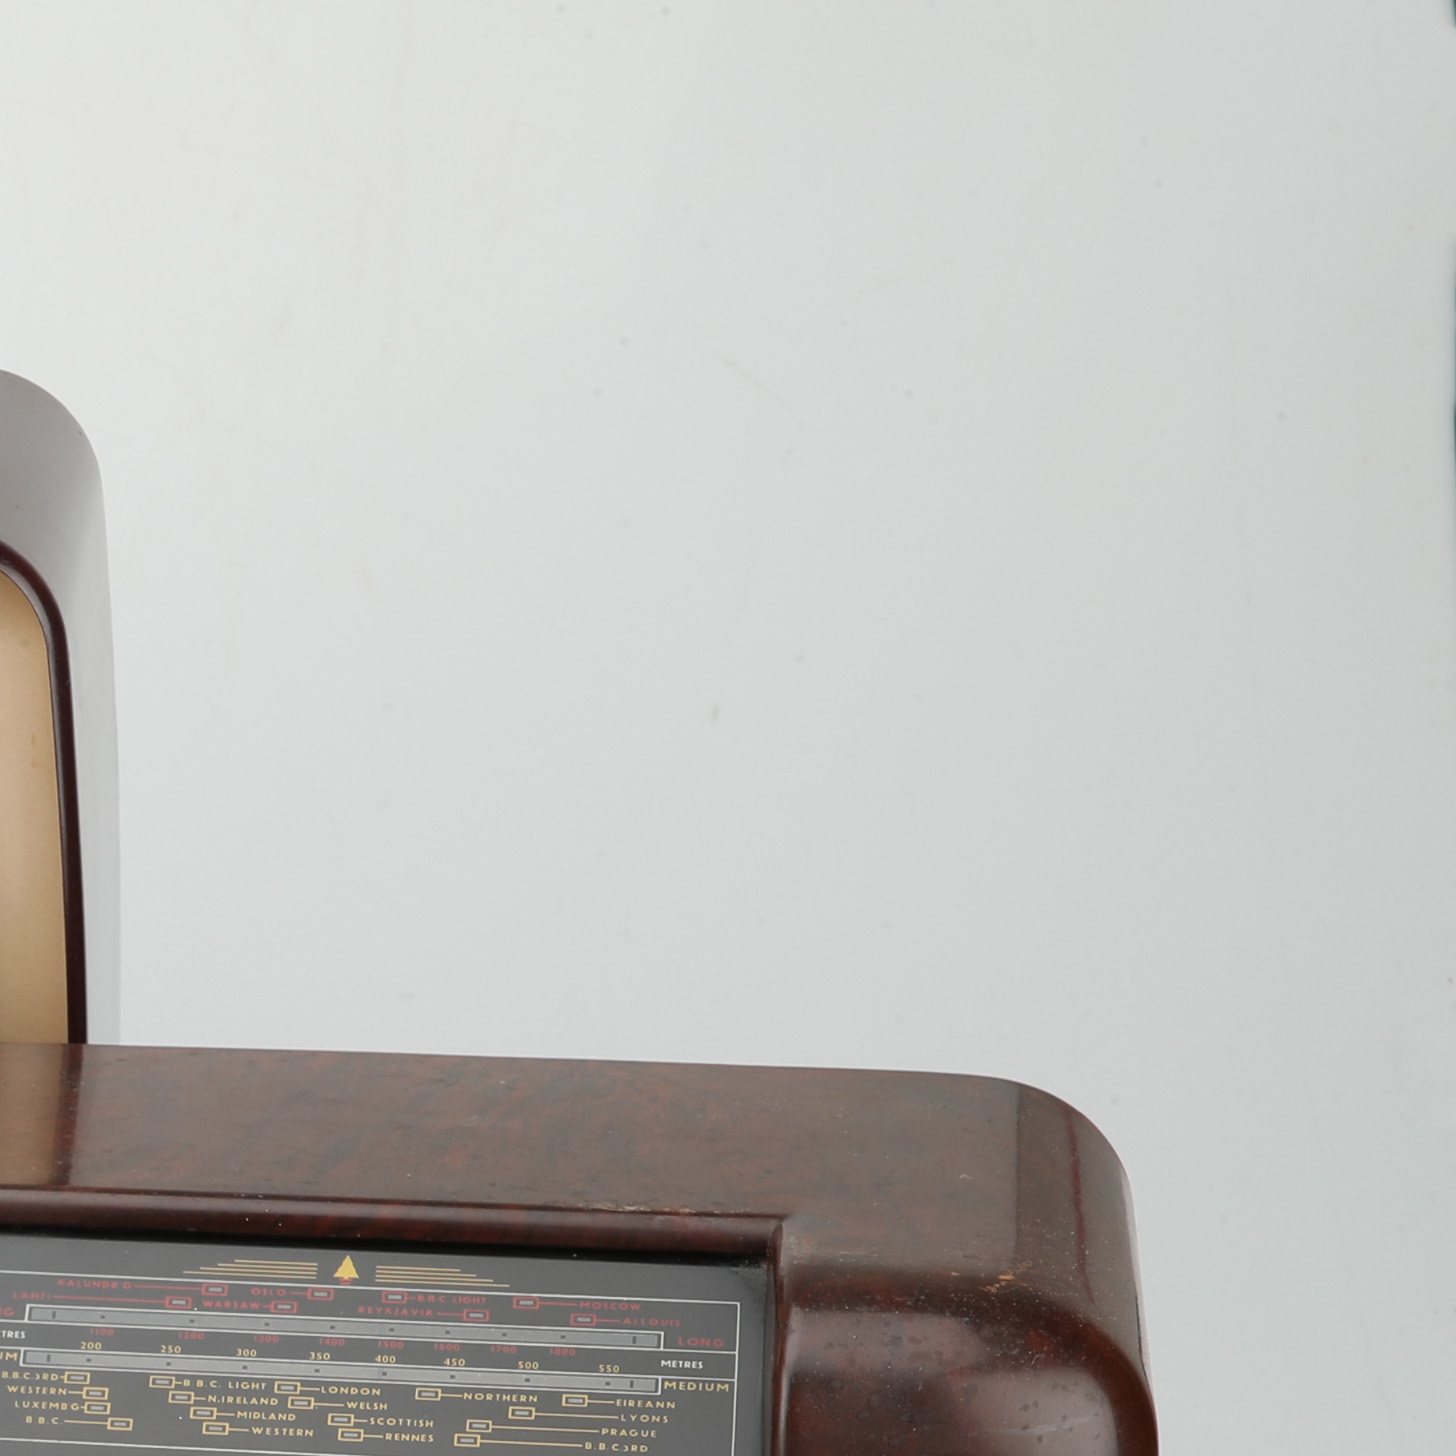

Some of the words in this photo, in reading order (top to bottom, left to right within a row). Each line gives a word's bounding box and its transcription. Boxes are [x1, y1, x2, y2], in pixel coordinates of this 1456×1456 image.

[251, 1288, 286, 1297] OSLO
[202, 1300, 261, 1310] WARSAW
[451, 1295, 488, 1304] LIGHT
[358, 1306, 433, 1317] REYKJAVIK
[580, 1301, 641, 1311] MOSCOW
[623, 1317, 681, 1327] ALLOUIS
[179, 1330, 204, 1340] 1200
[253, 1334, 279, 1344] 1300
[319, 1337, 345, 1347] 1400
[378, 1340, 404, 1350] 1500
[677, 1337, 725, 1348] LONG
[80, 1341, 102, 1351] 200
[160, 1344, 182, 1354] 250
[236, 1348, 257, 1358] 300
[309, 1351, 331, 1361] 350
[374, 1354, 396, 1364] 400
[444, 1357, 466, 1367] 450
[518, 1360, 539, 1370] 500
[598, 1363, 620, 1374] 550
[660, 1359, 703, 1370] METRES
[7, 1385, 67, 1396] WESTERN
[228, 1381, 267, 1390] LIGHT
[321, 1386, 381, 1396] LONDON
[663, 1380, 730, 1392] MEDIUM
[463, 1392, 538, 1403] NORTHERN
[346, 1401, 388, 1411] WELSH
[616, 1398, 676, 1409] EIREANN
[237, 1411, 297, 1422] MIDLAND
[621, 1413, 670, 1424] LYONS
[369, 1417, 435, 1428] SCOTTISH
[251, 1426, 314, 1437] WESTERN
[601, 1428, 657, 1438] PRAGUE
[385, 1433, 434, 1443] RENNES
